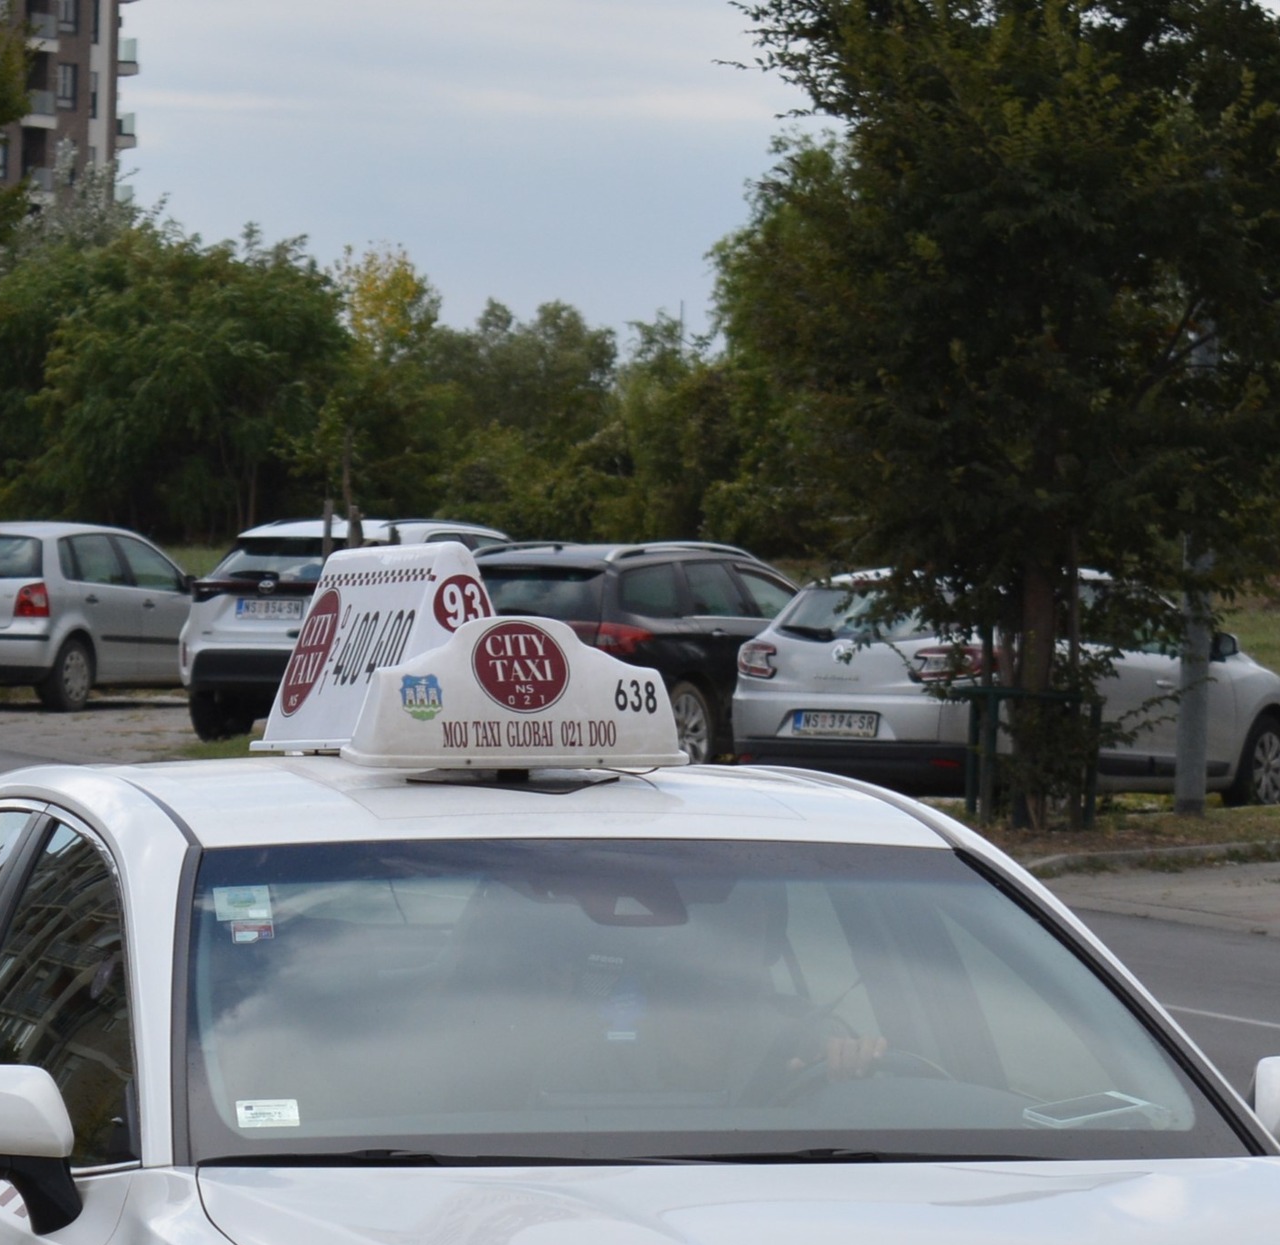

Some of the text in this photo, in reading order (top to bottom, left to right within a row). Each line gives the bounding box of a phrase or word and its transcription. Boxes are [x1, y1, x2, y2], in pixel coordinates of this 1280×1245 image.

[442, 583, 485, 628] 93
[301, 613, 338, 648] CITY
[485, 634, 546, 657] CITY
[333, 611, 380, 686] 400
[288, 652, 324, 686] TAXI
[489, 659, 554, 682] TAXI
[515, 684, 534, 694] NS
[614, 679, 657, 714] 638
[442, 721, 468, 748] MOJ
[472, 721, 501, 747] TAXI
[561, 721, 583, 747] 021
[588, 720, 617, 747] DOO
[803, 714, 819, 728] NS
